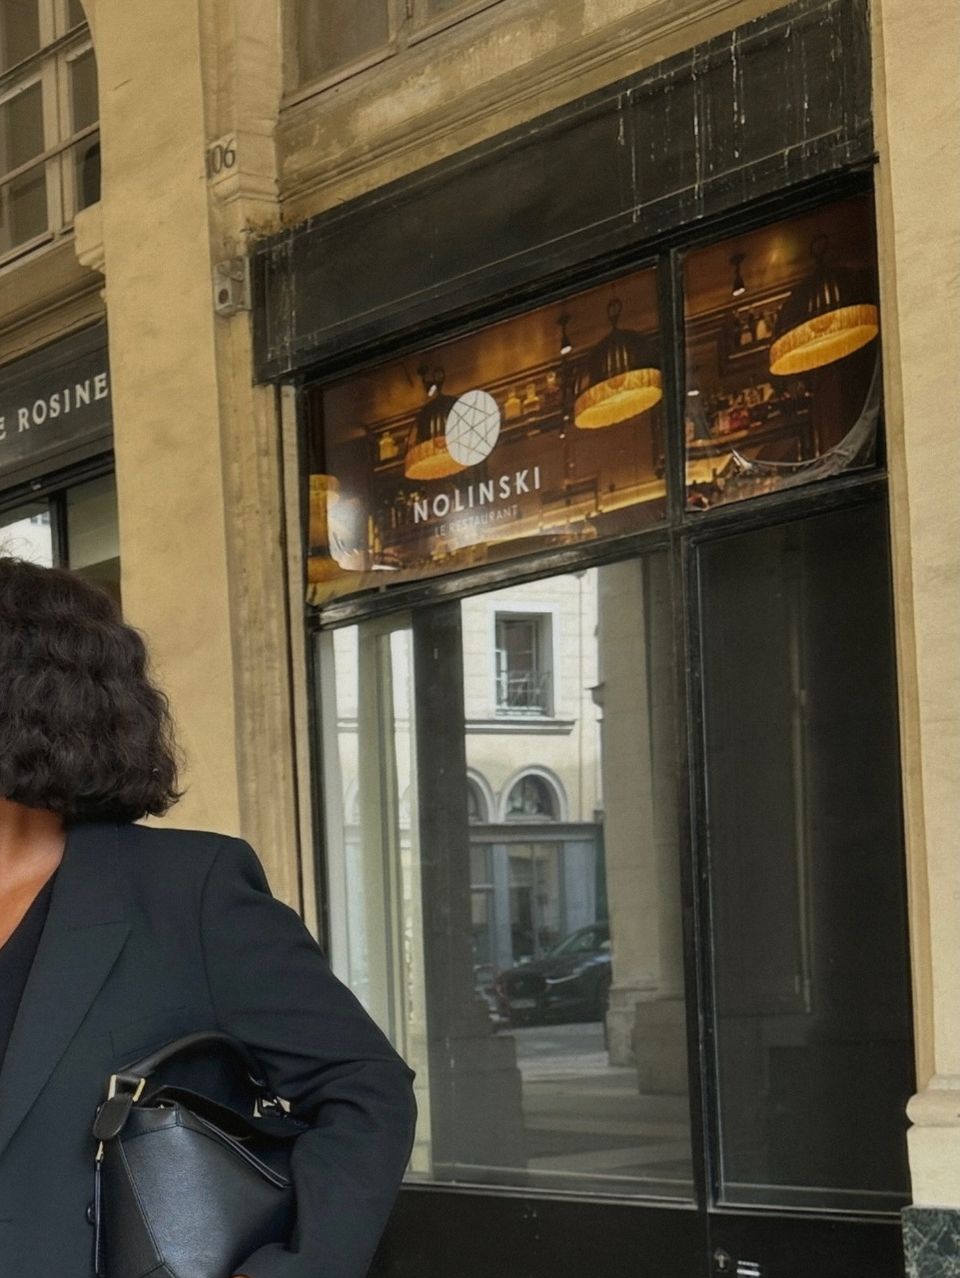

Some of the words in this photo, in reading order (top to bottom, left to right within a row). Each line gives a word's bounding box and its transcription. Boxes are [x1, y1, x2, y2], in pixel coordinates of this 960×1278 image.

[18, 372, 109, 432] ROSINE
[413, 466, 540, 524] NOLINSKI
[448, 504, 519, 534] RESTAURANT
